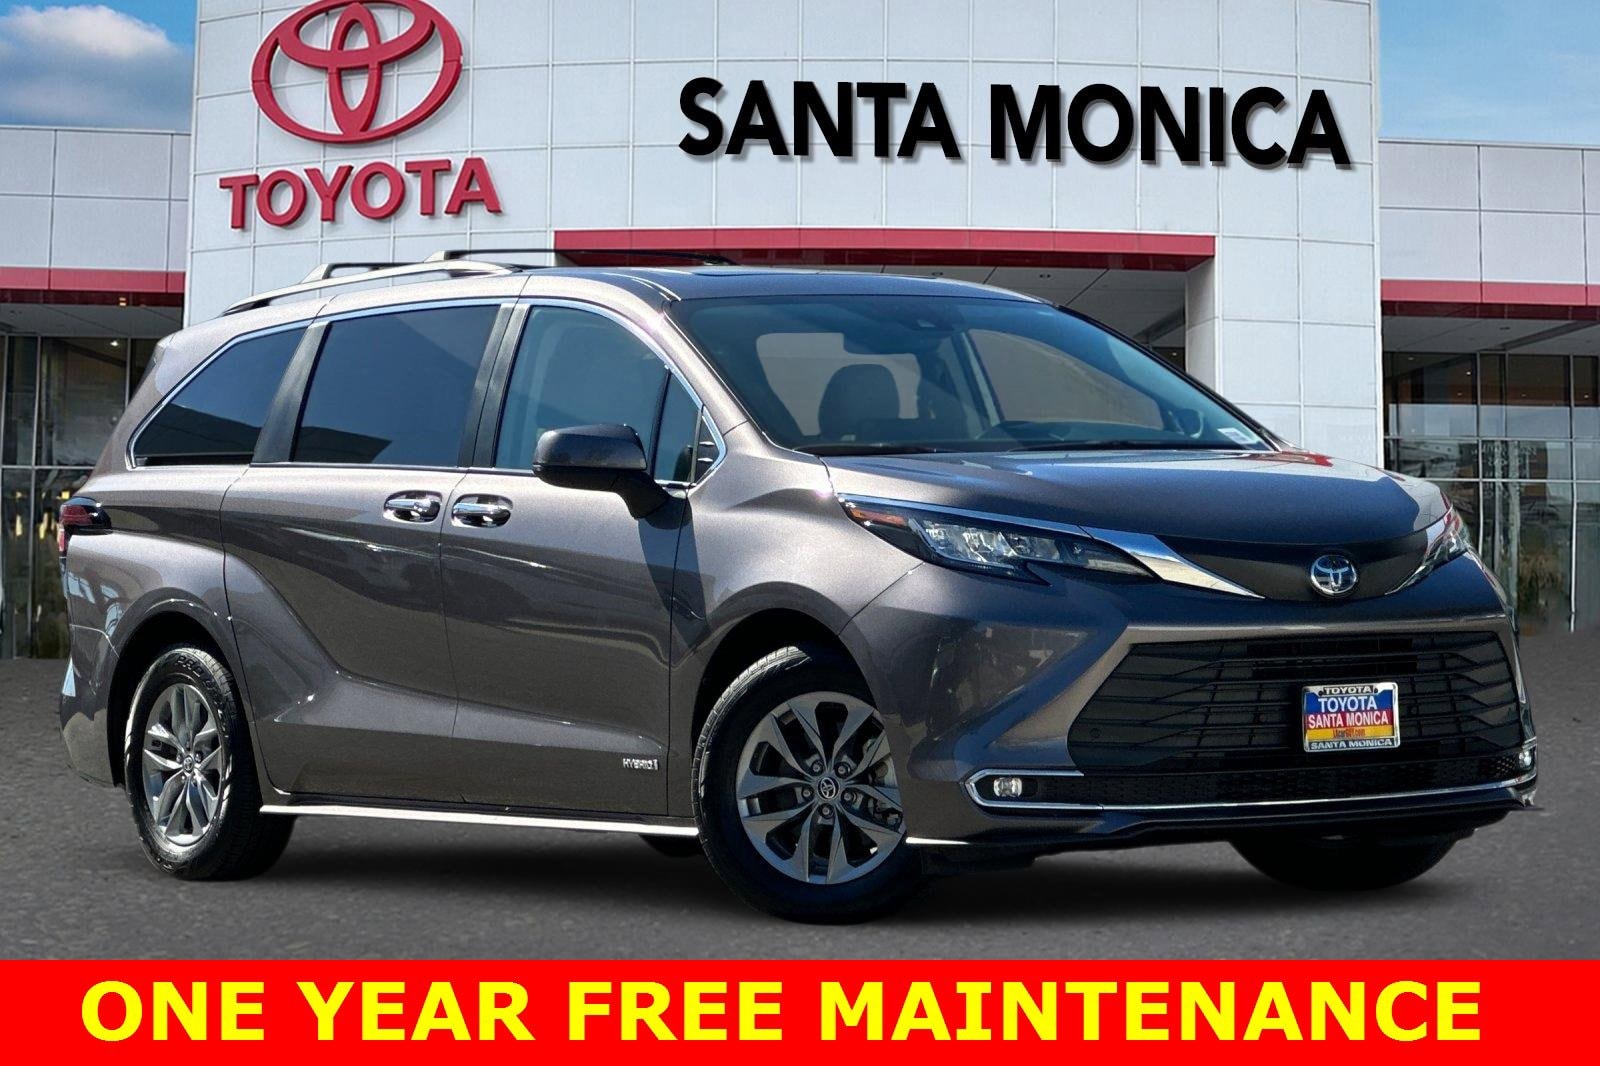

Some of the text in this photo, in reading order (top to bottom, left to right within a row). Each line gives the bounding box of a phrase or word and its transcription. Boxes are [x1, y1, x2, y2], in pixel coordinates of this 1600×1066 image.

[679, 78, 1351, 168] SANTA MONICA
[220, 157, 502, 229] TOYOTA
[1324, 686, 1372, 695] TOYOTA
[1318, 696, 1377, 712] TOYOTA
[1308, 711, 1389, 729] SANTA MONICA
[1311, 738, 1393, 750] SANTA MONICA
